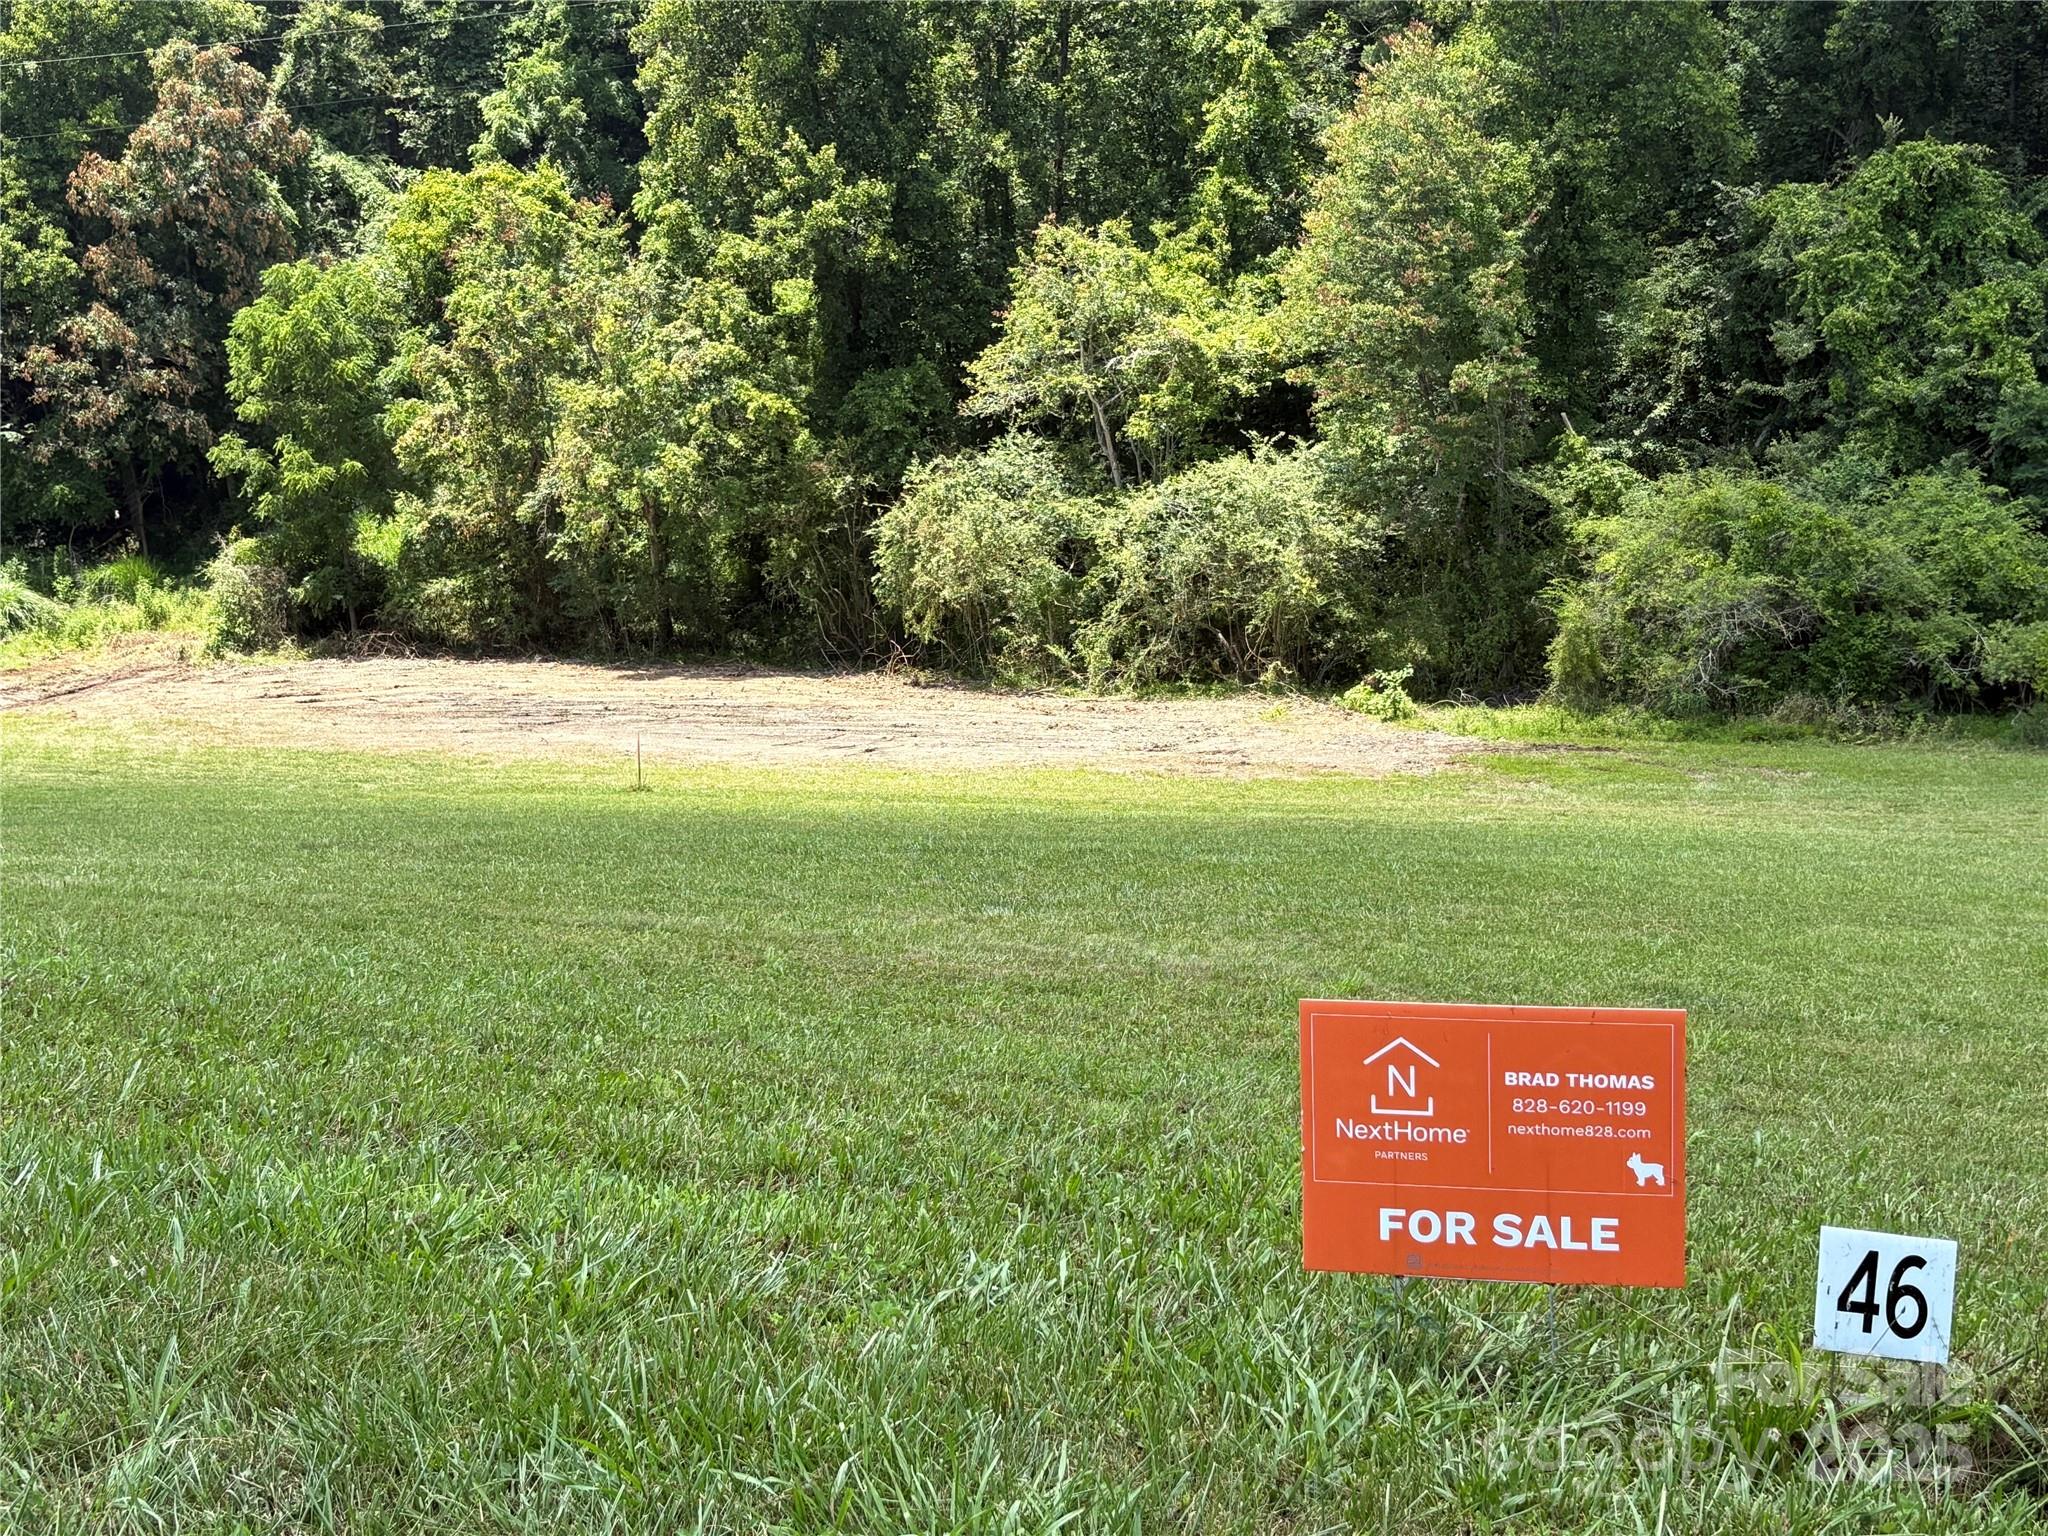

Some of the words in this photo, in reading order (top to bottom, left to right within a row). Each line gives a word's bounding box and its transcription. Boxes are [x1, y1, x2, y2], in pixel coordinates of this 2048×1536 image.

[1388, 1064, 1415, 1097] N
[1504, 1071, 1560, 1087] BRAD
[1565, 1073, 1655, 1090] THOMAS
[1512, 1098, 1647, 1116] 828-620-1199
[1336, 1117, 1467, 1144] NextHome
[1507, 1122, 1651, 1139] nexthome828.com
[1374, 1150, 1428, 1161] PARTNERS
[1379, 1207, 1477, 1246] FOR
[1492, 1213, 1620, 1252] SALE
[1837, 1249, 1929, 1340] 46
